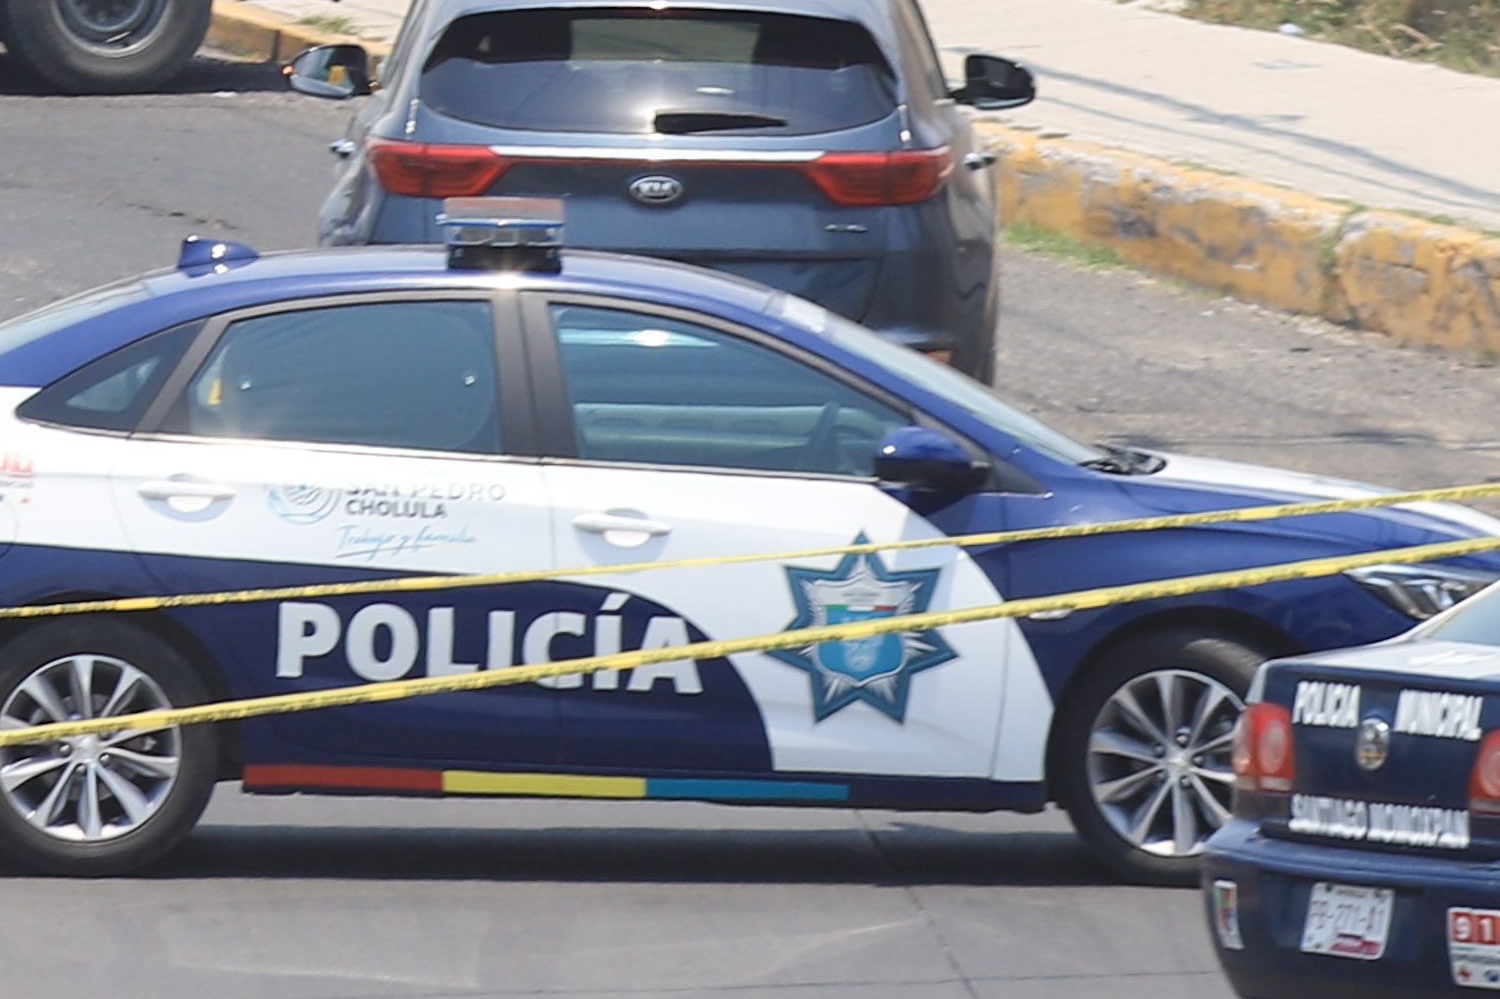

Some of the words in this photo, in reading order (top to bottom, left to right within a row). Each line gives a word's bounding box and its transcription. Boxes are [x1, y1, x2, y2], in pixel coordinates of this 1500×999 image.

[345, 499, 448, 518] CHOLULA
[276, 592, 704, 694] POLICÍA
[1291, 680, 1361, 728] POLICIA
[1393, 688, 1484, 741] MUNICIPAL
